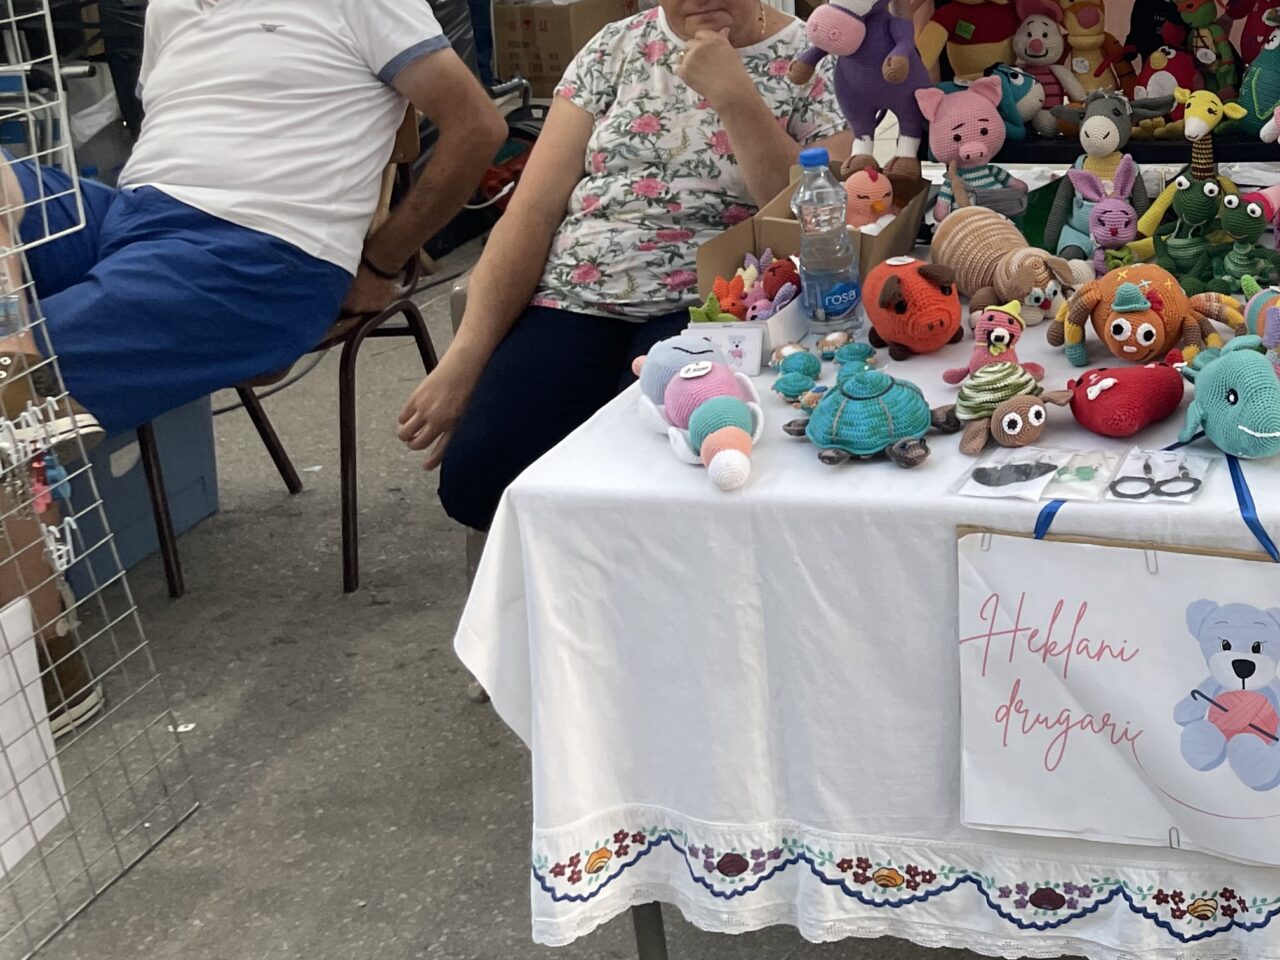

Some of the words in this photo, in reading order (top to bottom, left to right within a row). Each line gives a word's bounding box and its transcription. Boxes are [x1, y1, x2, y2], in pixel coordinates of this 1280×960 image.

[825, 289, 857, 306] rosa
[958, 591, 1139, 679] Heklani
[993, 677, 1144, 772] drugari
